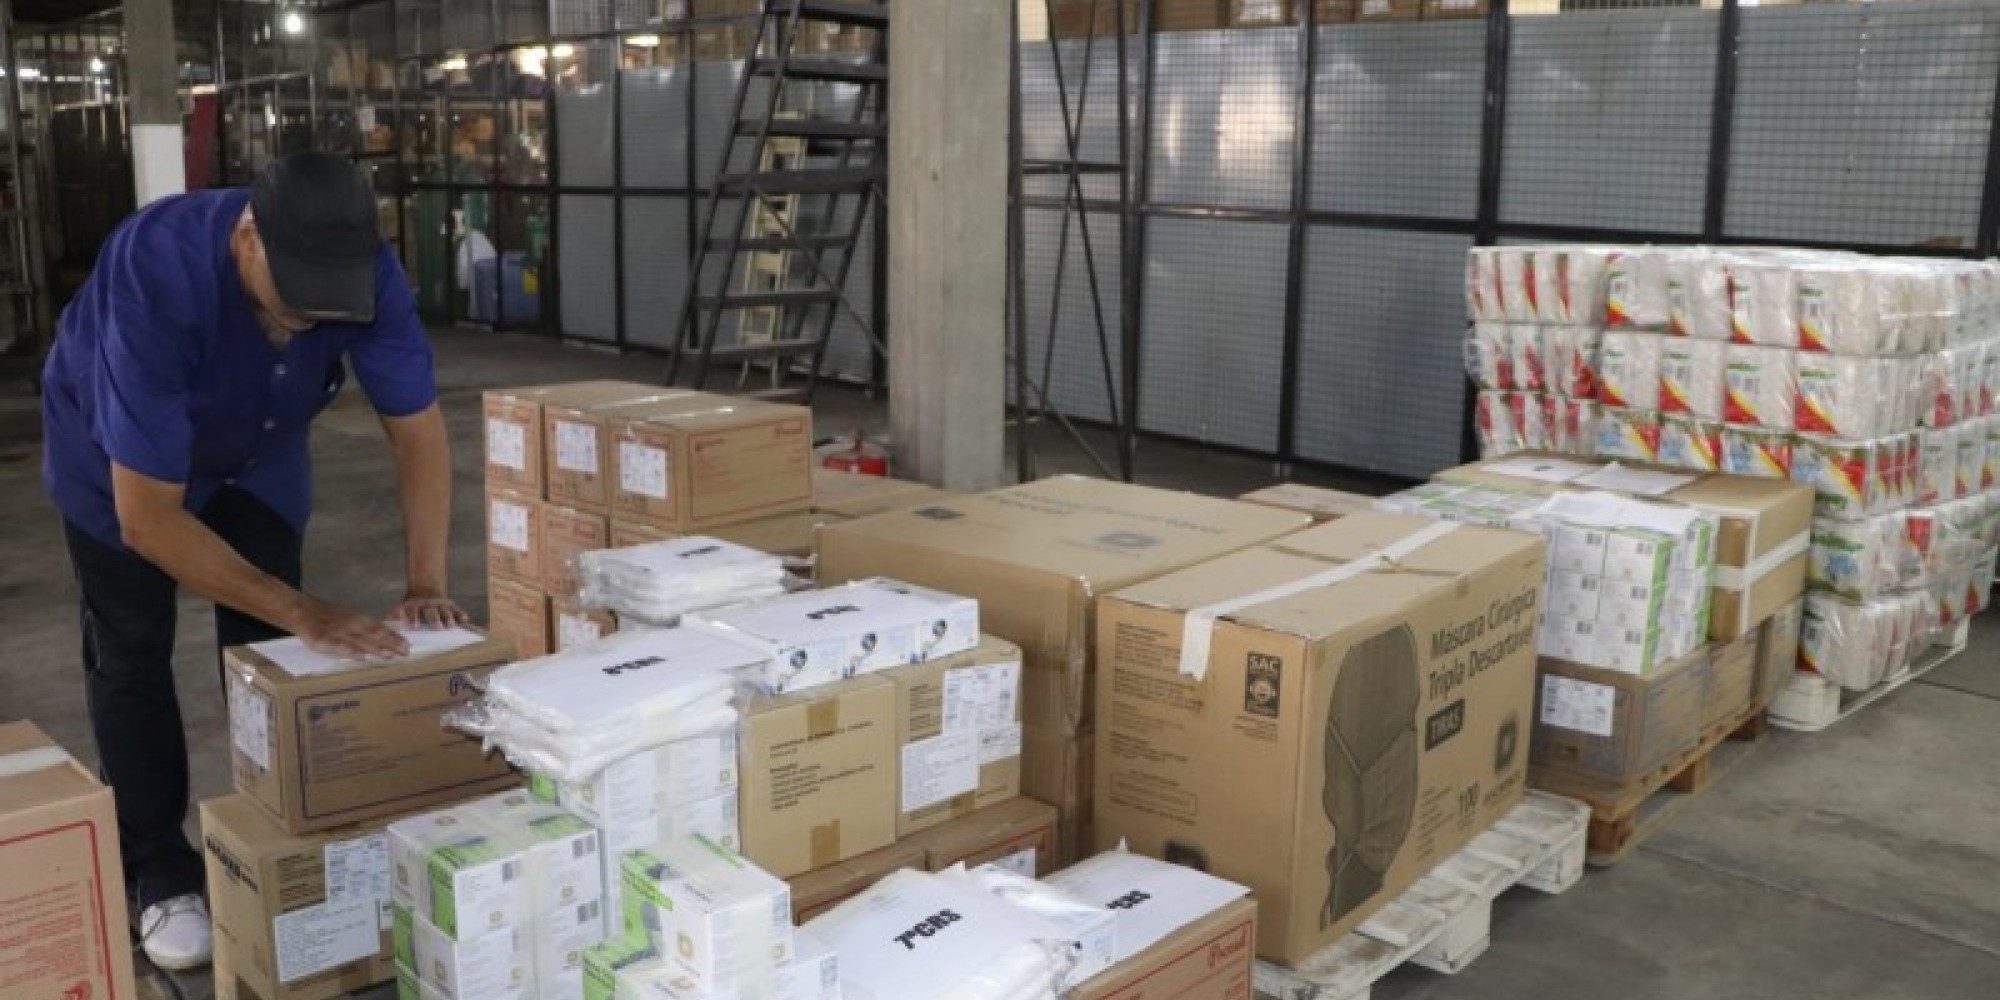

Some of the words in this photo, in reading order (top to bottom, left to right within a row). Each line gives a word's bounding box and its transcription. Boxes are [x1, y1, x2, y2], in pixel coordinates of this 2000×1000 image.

[1429, 614, 1486, 661] Máscara
[1249, 654, 1281, 671] SAC
[1428, 655, 1466, 701] Tripla
